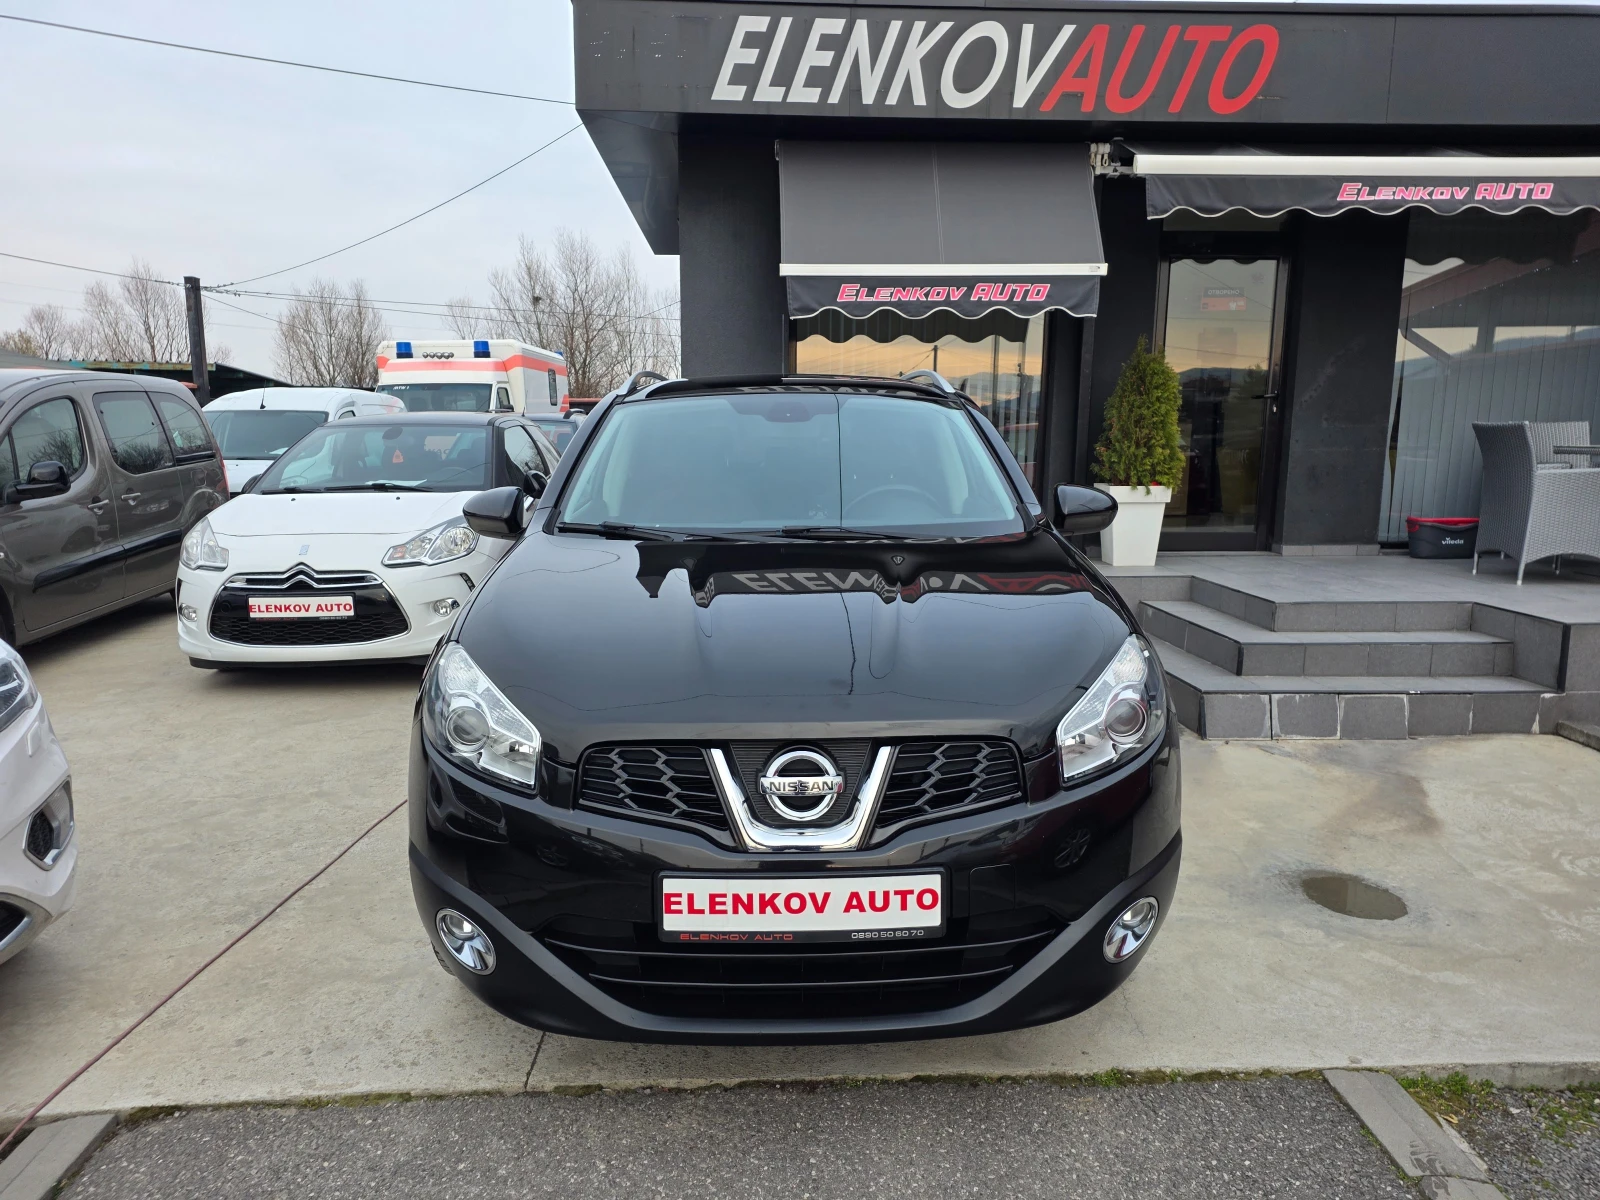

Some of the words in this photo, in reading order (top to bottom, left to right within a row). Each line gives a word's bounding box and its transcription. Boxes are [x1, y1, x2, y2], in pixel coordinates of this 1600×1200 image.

[1474, 182, 1554, 200] AUTO
[970, 283, 1051, 302] AUTO
[1441, 536, 1464, 545] vileda
[249, 603, 310, 613] ELENKOV
[315, 603, 352, 612] AUTO
[769, 780, 834, 792] NISSAN
[663, 891, 832, 915] ELENKOV
[843, 888, 939, 913] AUTO
[680, 933, 749, 941] ELENKOV
